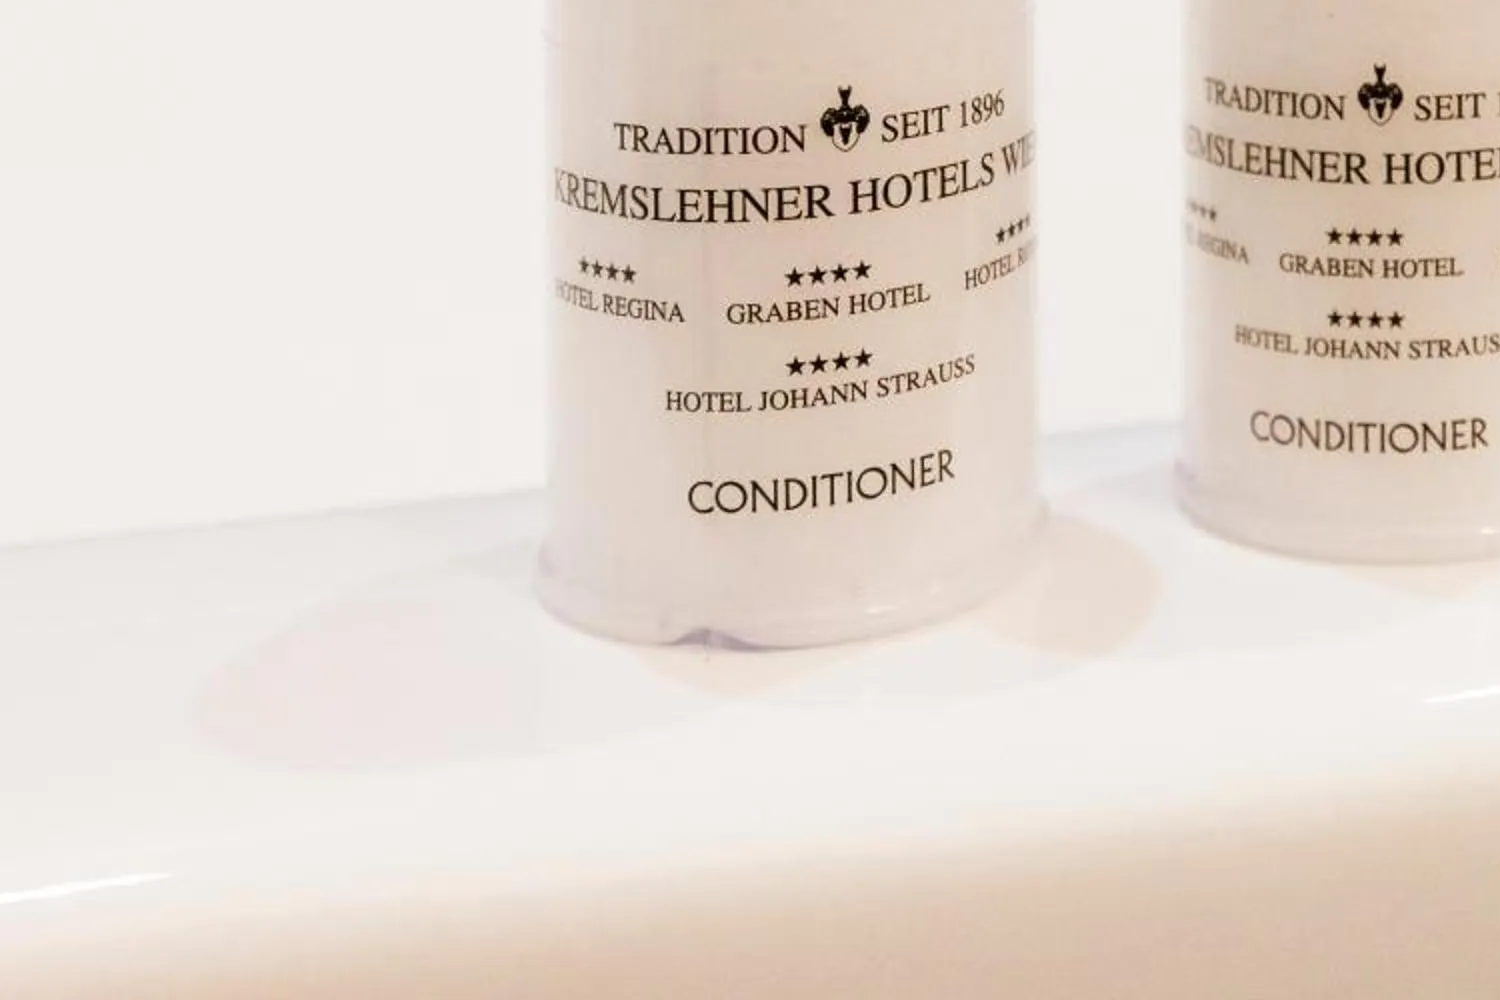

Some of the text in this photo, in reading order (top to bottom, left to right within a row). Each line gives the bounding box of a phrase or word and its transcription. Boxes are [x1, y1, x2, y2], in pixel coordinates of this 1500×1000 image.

[613, 89, 1005, 155] TRADITION SEIT 1896
[1203, 77, 1346, 121] TRADITION
[1413, 91, 1486, 123] SEIT
[555, 129, 1036, 224] KREMSLEHNER HOTELS WIE
[1186, 124, 1371, 185] EMSLEHNER
[964, 254, 1014, 290] HOTEL
[1279, 252, 1464, 279] GRABEN HOTEL
[602, 293, 685, 323] REGINA
[726, 284, 931, 325] GRABEN HOTEL
[1234, 324, 1300, 356] HOTEL
[1304, 336, 1401, 360] JOHANN
[665, 354, 977, 413] HOTEL JOHANN STRAUSS
[1250, 410, 1489, 454] CONDITIONER
[687, 449, 956, 515] CONDITIONER
